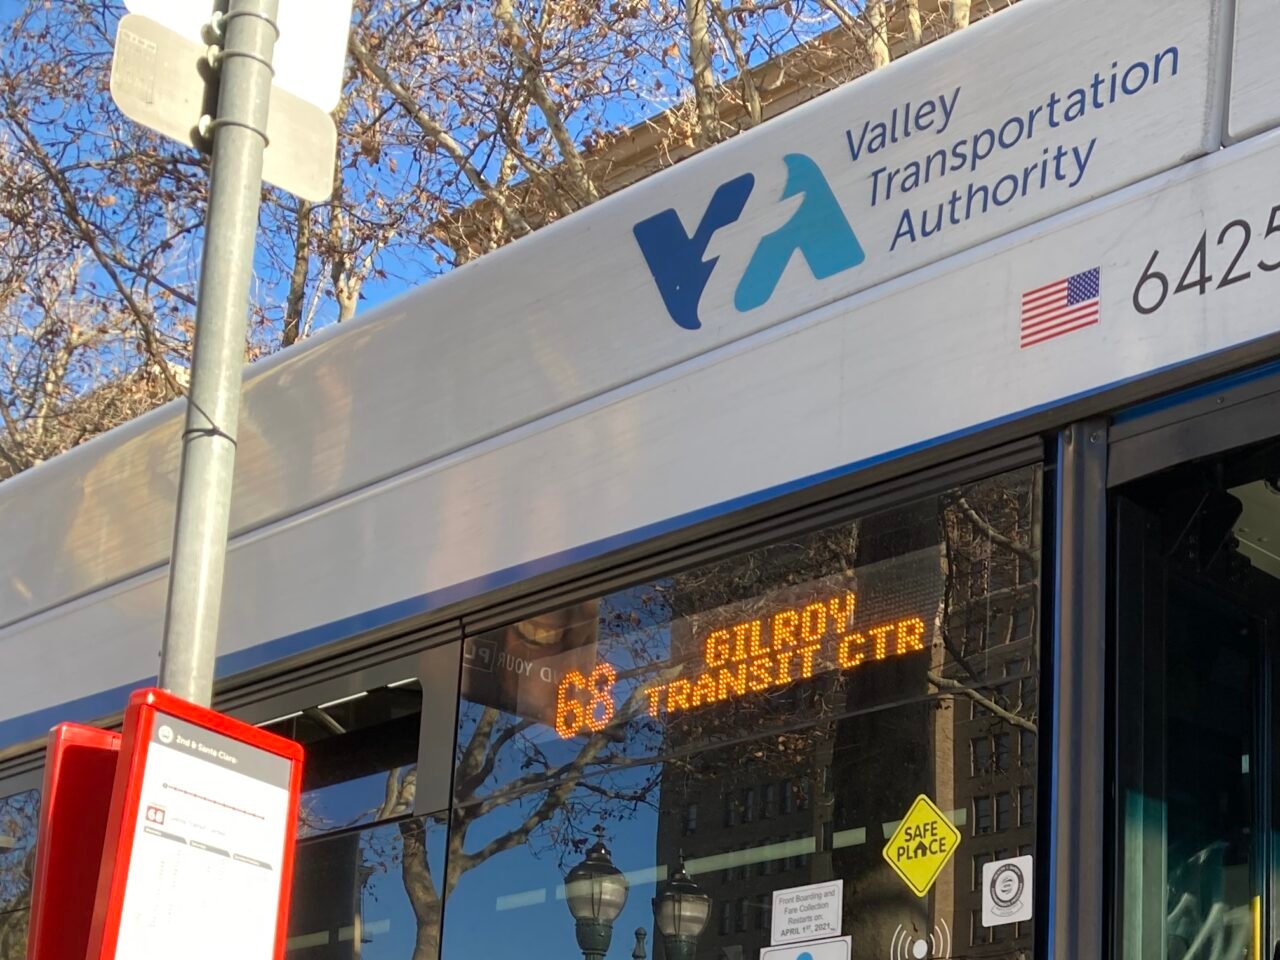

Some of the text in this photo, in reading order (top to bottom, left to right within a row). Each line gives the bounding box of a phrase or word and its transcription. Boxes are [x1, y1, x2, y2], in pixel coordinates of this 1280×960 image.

[845, 86, 962, 163] Valley
[867, 44, 1181, 208] Transportation
[889, 137, 1098, 252] Authority
[705, 593, 857, 668] GILROY
[643, 617, 927, 718] TRANSIT CTR
[555, 662, 618, 740] 68
[176, 735, 191, 748] 2nd
[198, 742, 218, 758] Santa
[904, 819, 940, 843] SAFE
[784, 902, 830, 916] Fare Collection
[795, 891, 823, 904] Boarding
[823, 888, 836, 898] and
[780, 928, 800, 937] APRIL
[787, 916, 813, 926] Restarts
